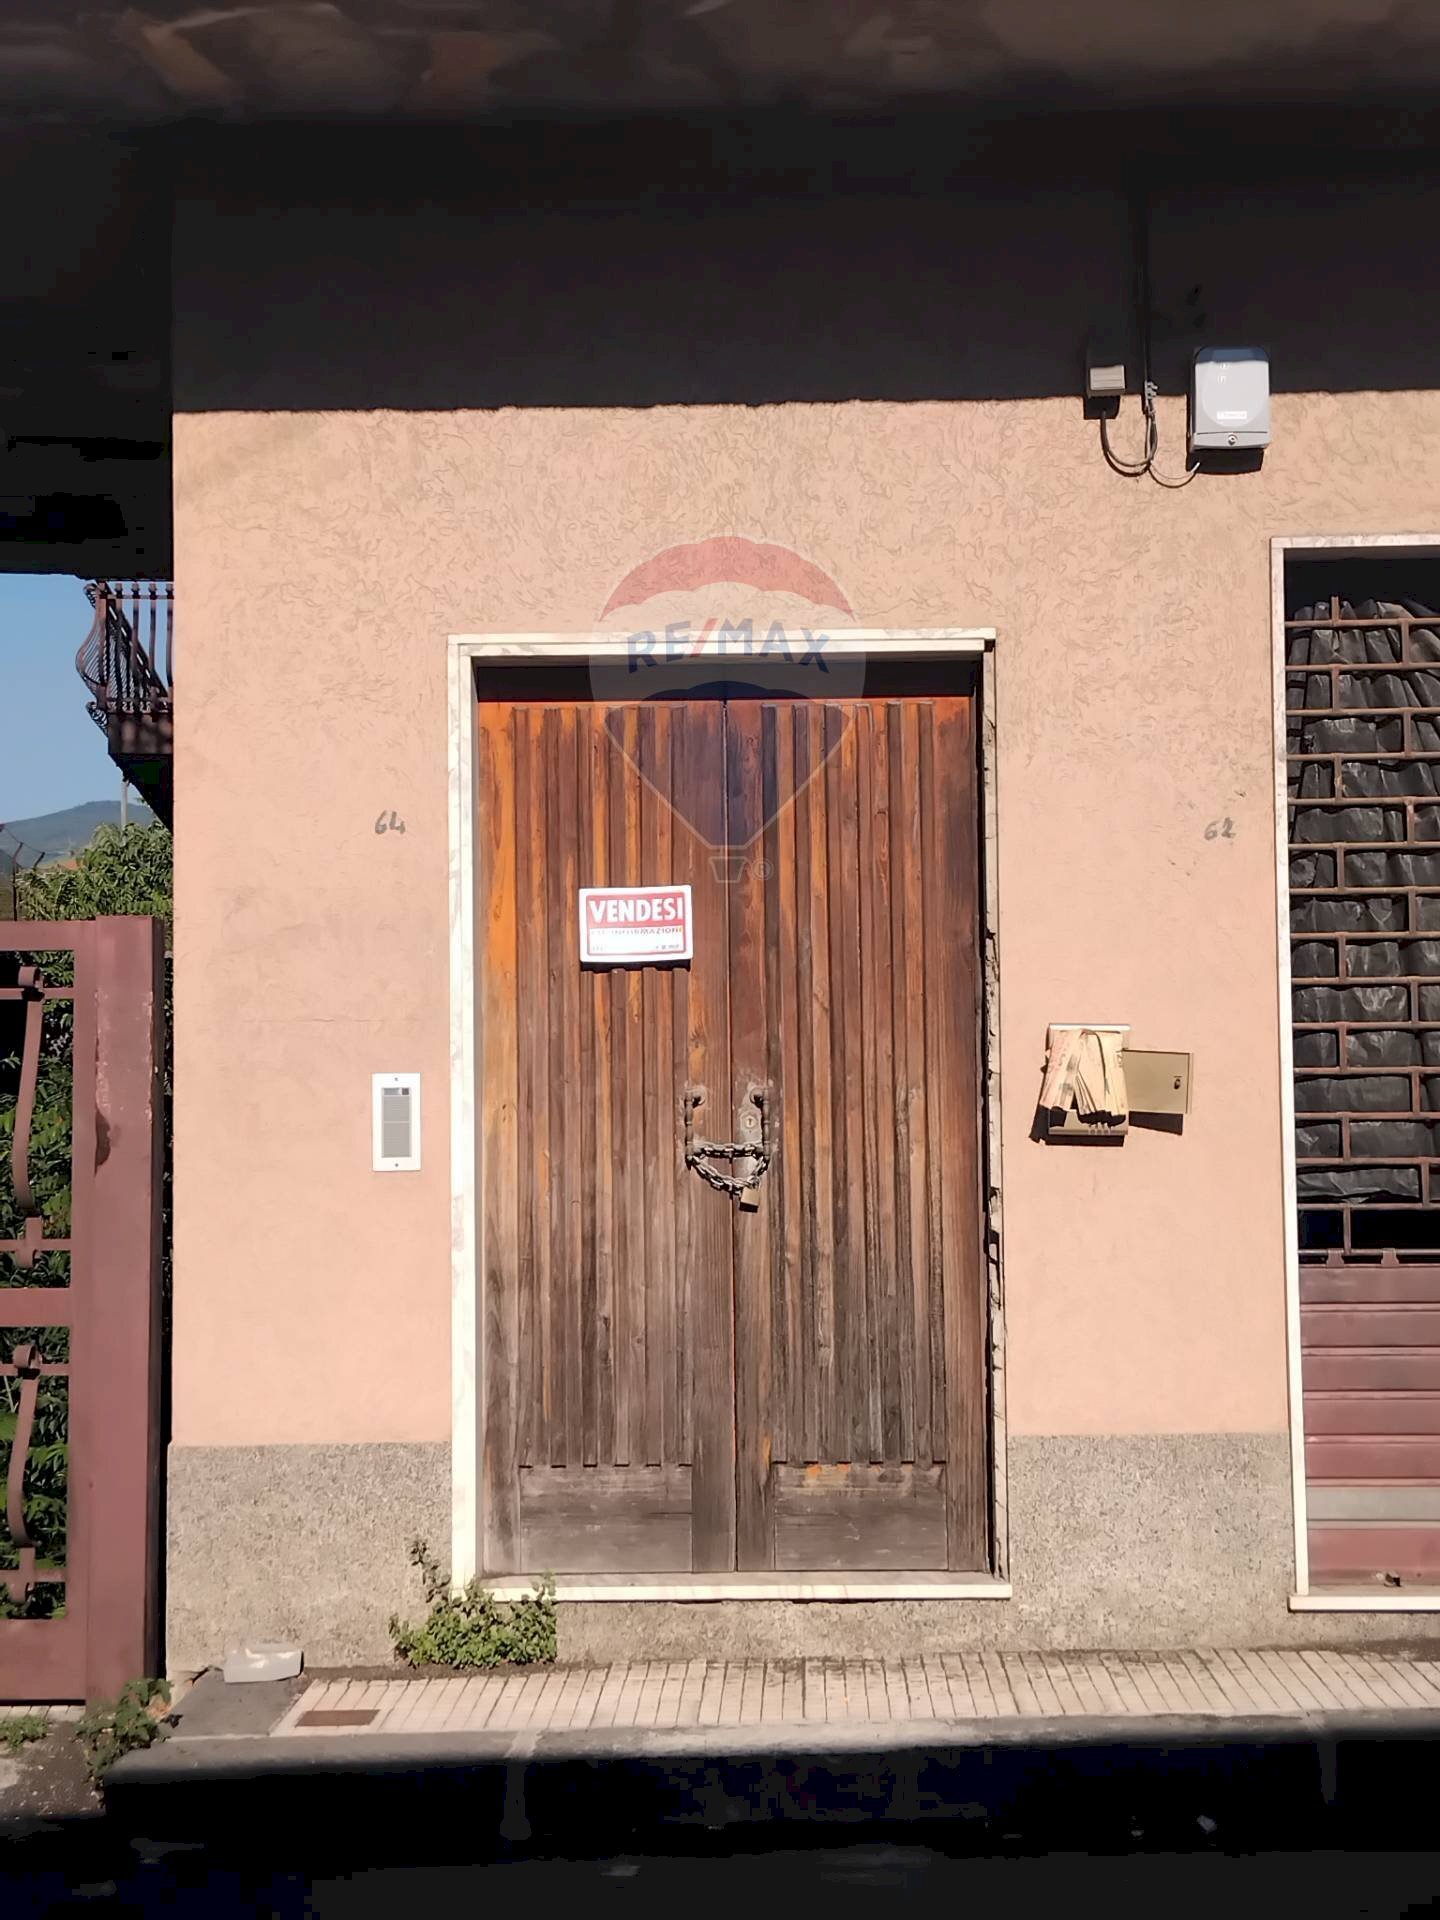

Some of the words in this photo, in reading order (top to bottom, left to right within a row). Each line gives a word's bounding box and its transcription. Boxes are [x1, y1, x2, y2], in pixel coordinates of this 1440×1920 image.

[374, 809, 406, 835] 64
[1203, 816, 1237, 841] 62
[588, 896, 683, 923] VENDESI
